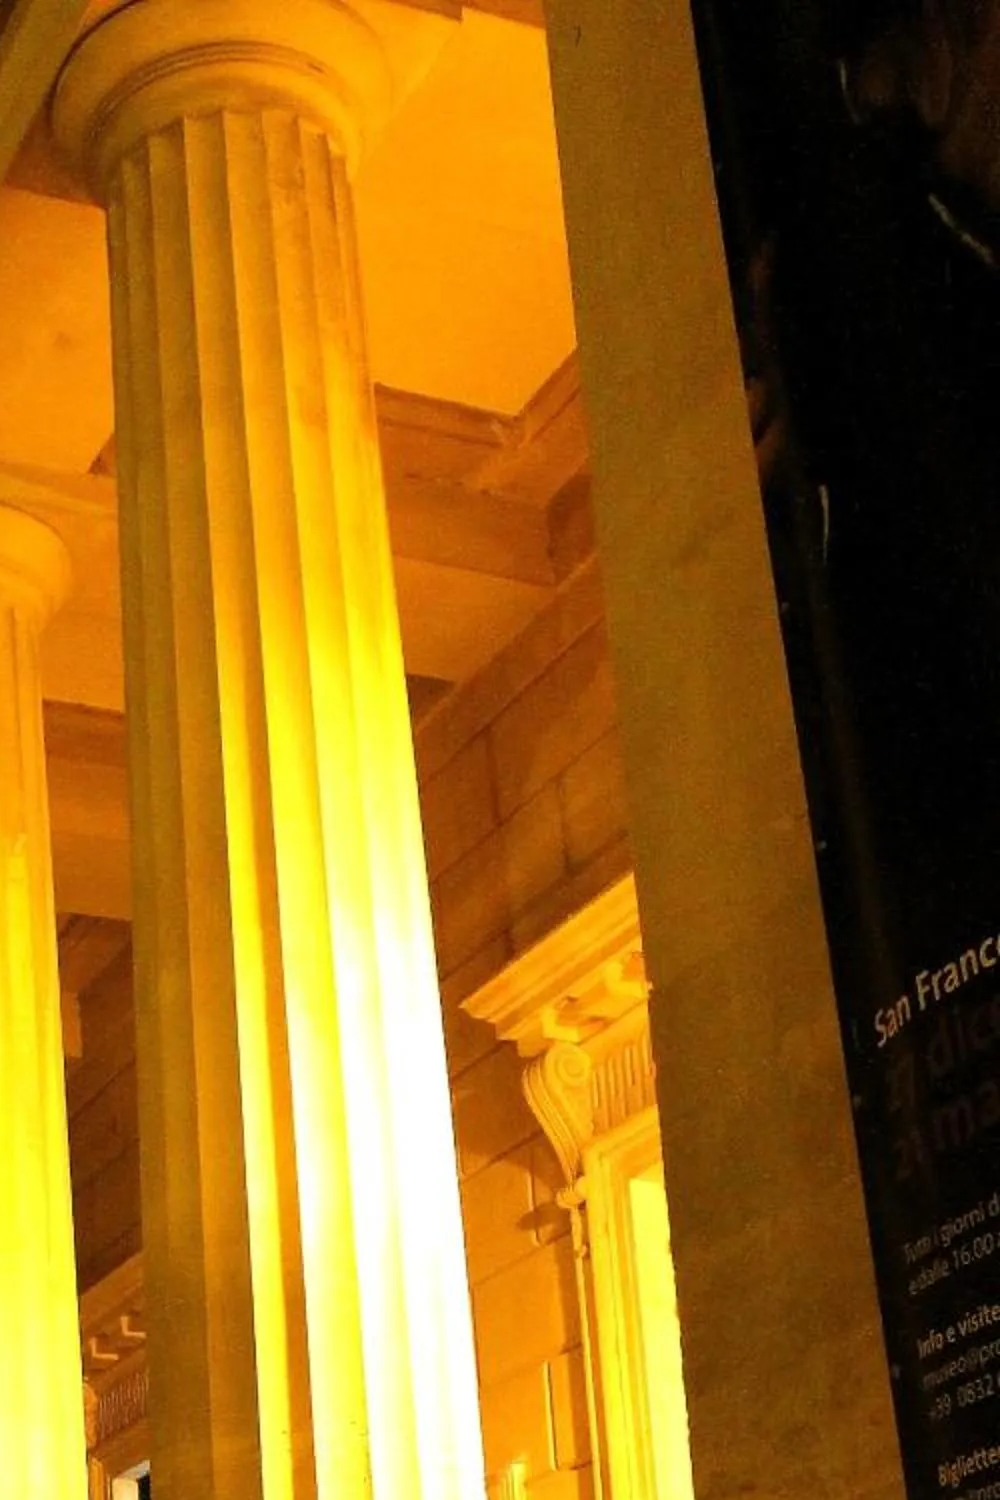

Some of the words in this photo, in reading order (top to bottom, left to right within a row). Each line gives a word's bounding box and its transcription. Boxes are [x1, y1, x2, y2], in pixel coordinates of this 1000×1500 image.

[874, 995, 911, 1047] San
[915, 933, 1000, 1011] Franc
[916, 1328, 943, 1360] Info
[945, 1325, 956, 1343] e
